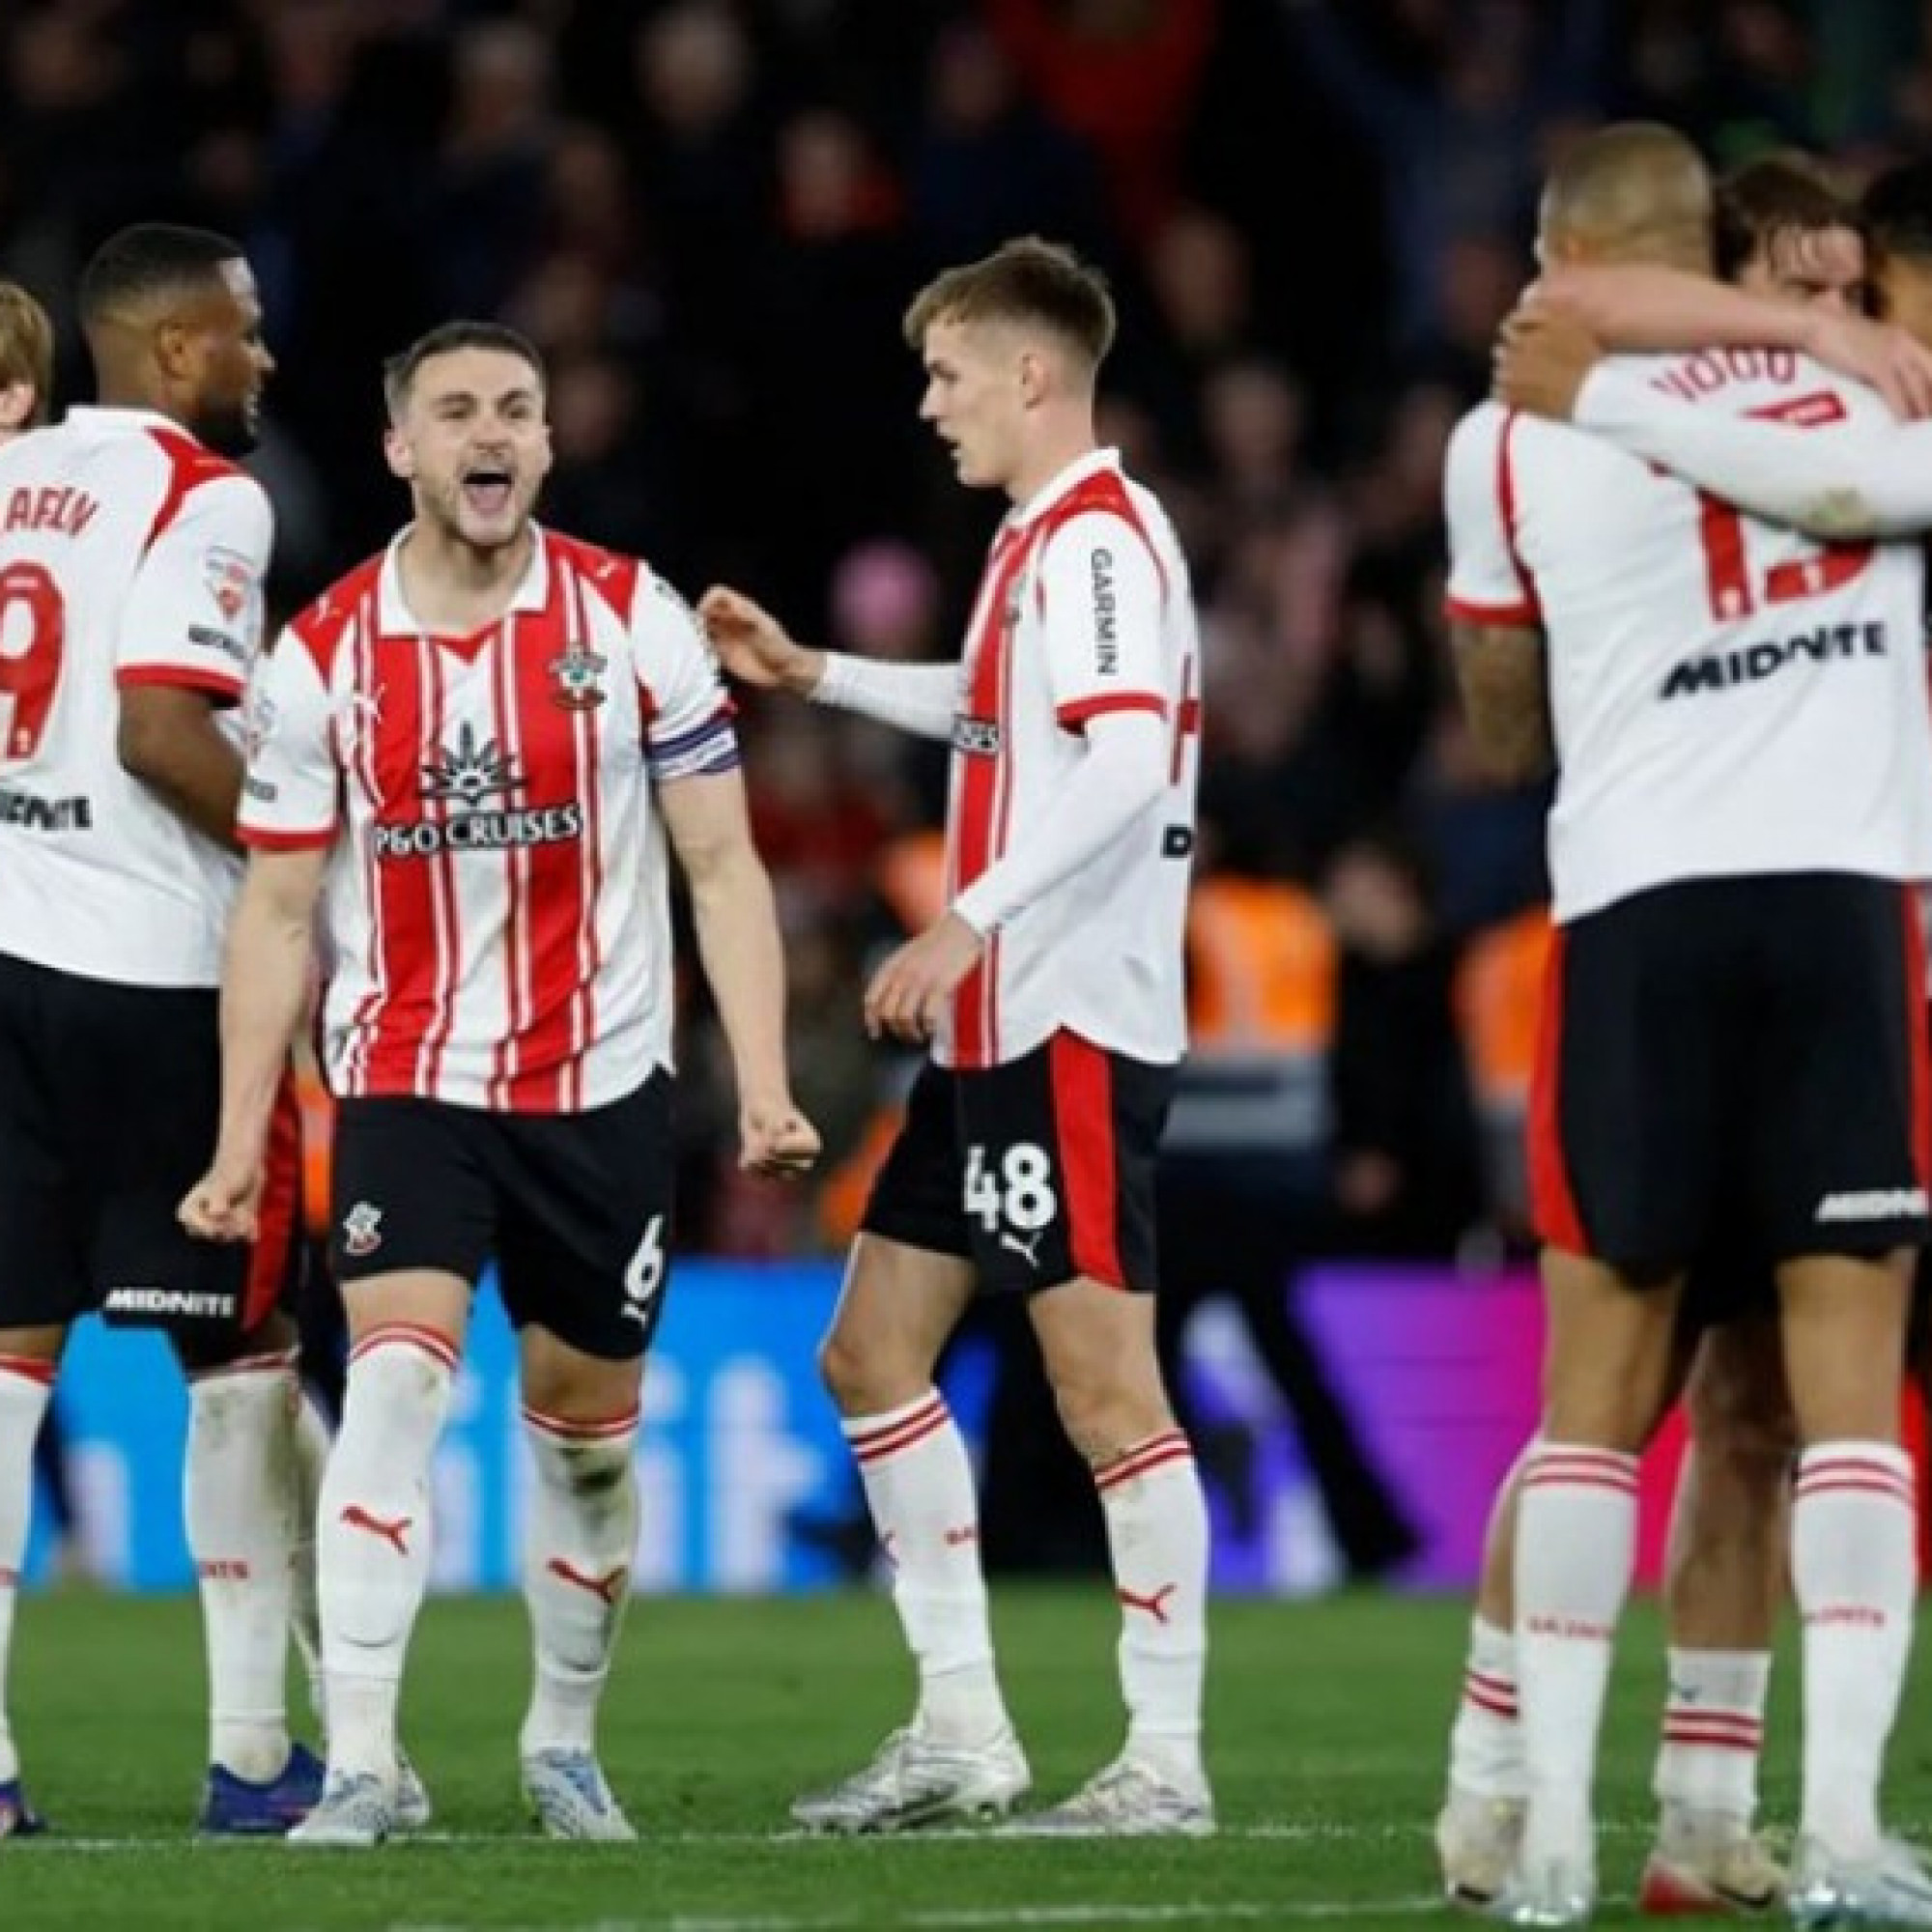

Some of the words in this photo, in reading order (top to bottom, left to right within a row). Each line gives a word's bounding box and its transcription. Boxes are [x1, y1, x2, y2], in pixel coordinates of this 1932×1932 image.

[1092, 548, 1119, 676] GARMIN
[446, 804, 583, 845] CRUISES
[965, 1143, 1055, 1232] 48
[625, 1213, 664, 1300] 6
[104, 1287, 236, 1318] MIDNITE
